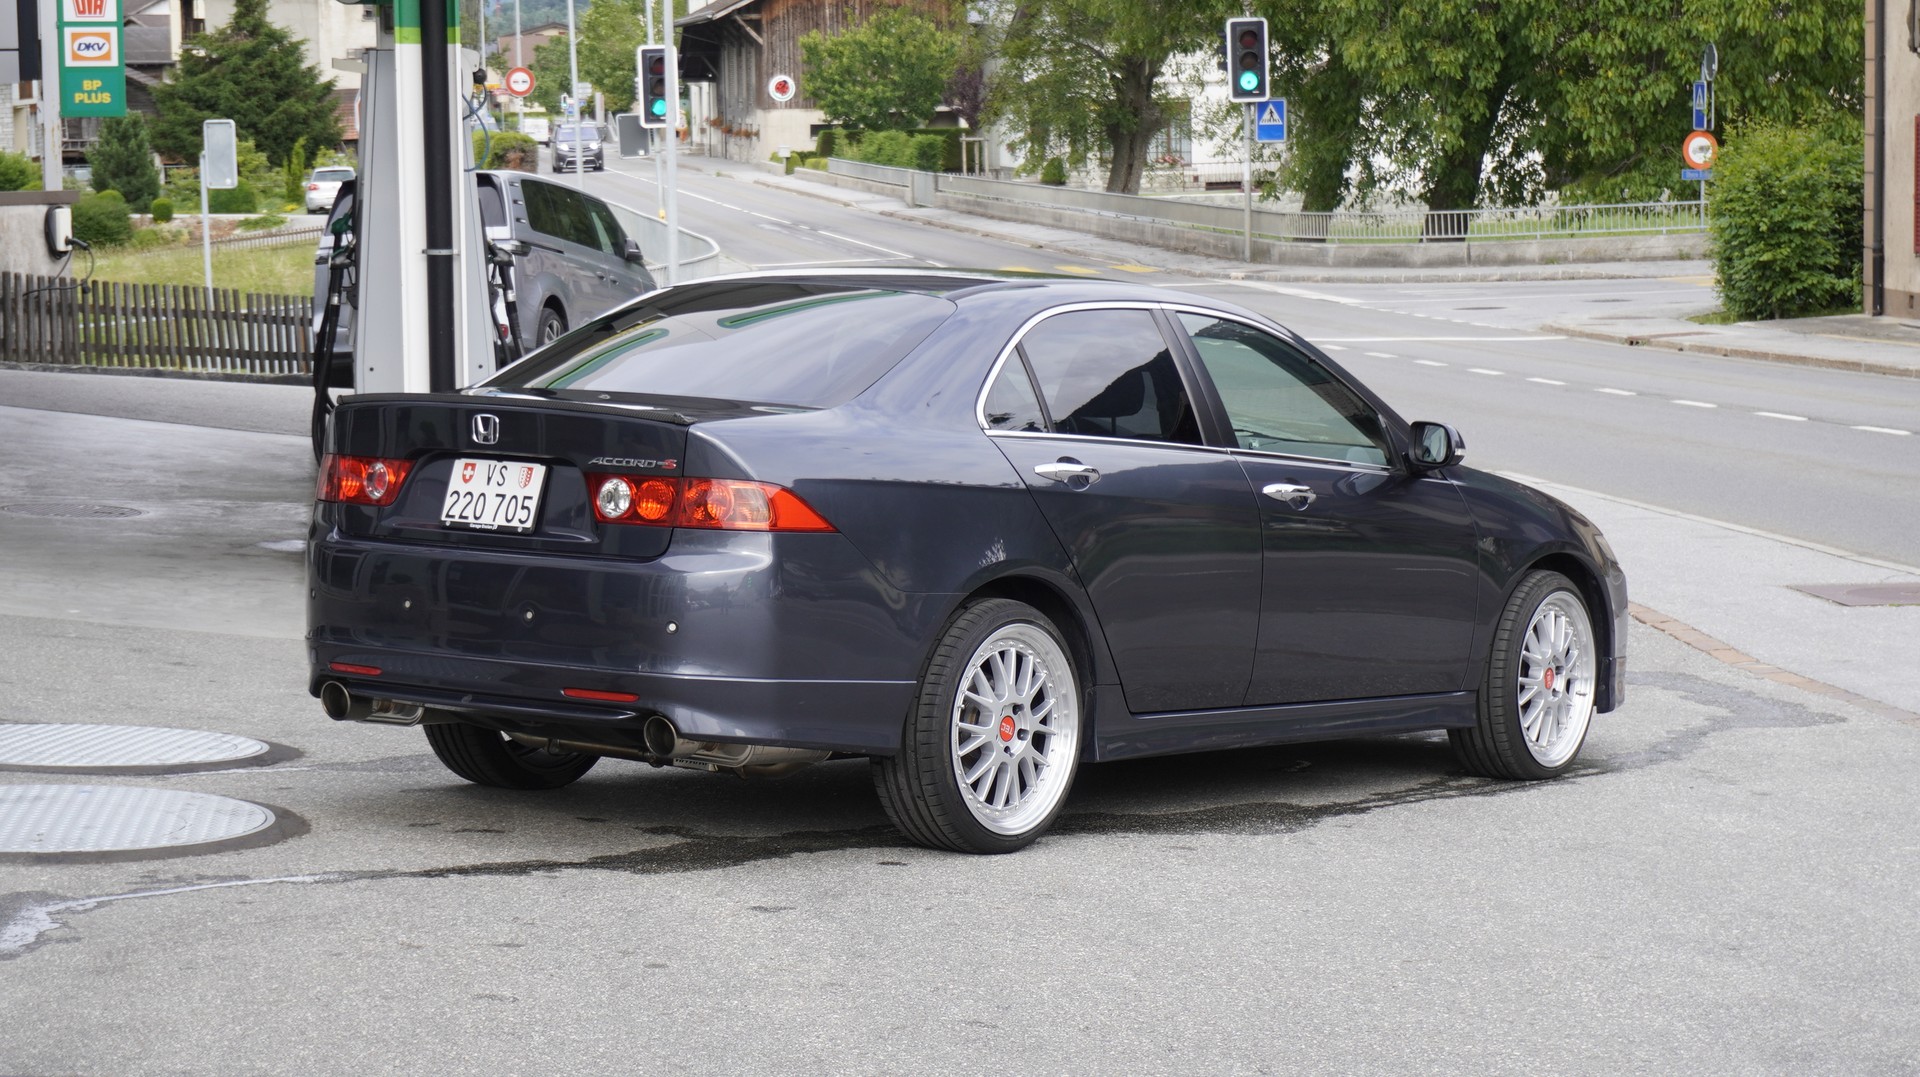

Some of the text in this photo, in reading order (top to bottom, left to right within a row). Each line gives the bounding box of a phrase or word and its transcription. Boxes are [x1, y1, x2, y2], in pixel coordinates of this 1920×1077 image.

[77, 42, 105, 52] DKV
[82, 80, 102, 91] BP
[74, 92, 112, 104] PLUS
[486, 463, 508, 487] VS
[445, 490, 534, 525] 220 705
